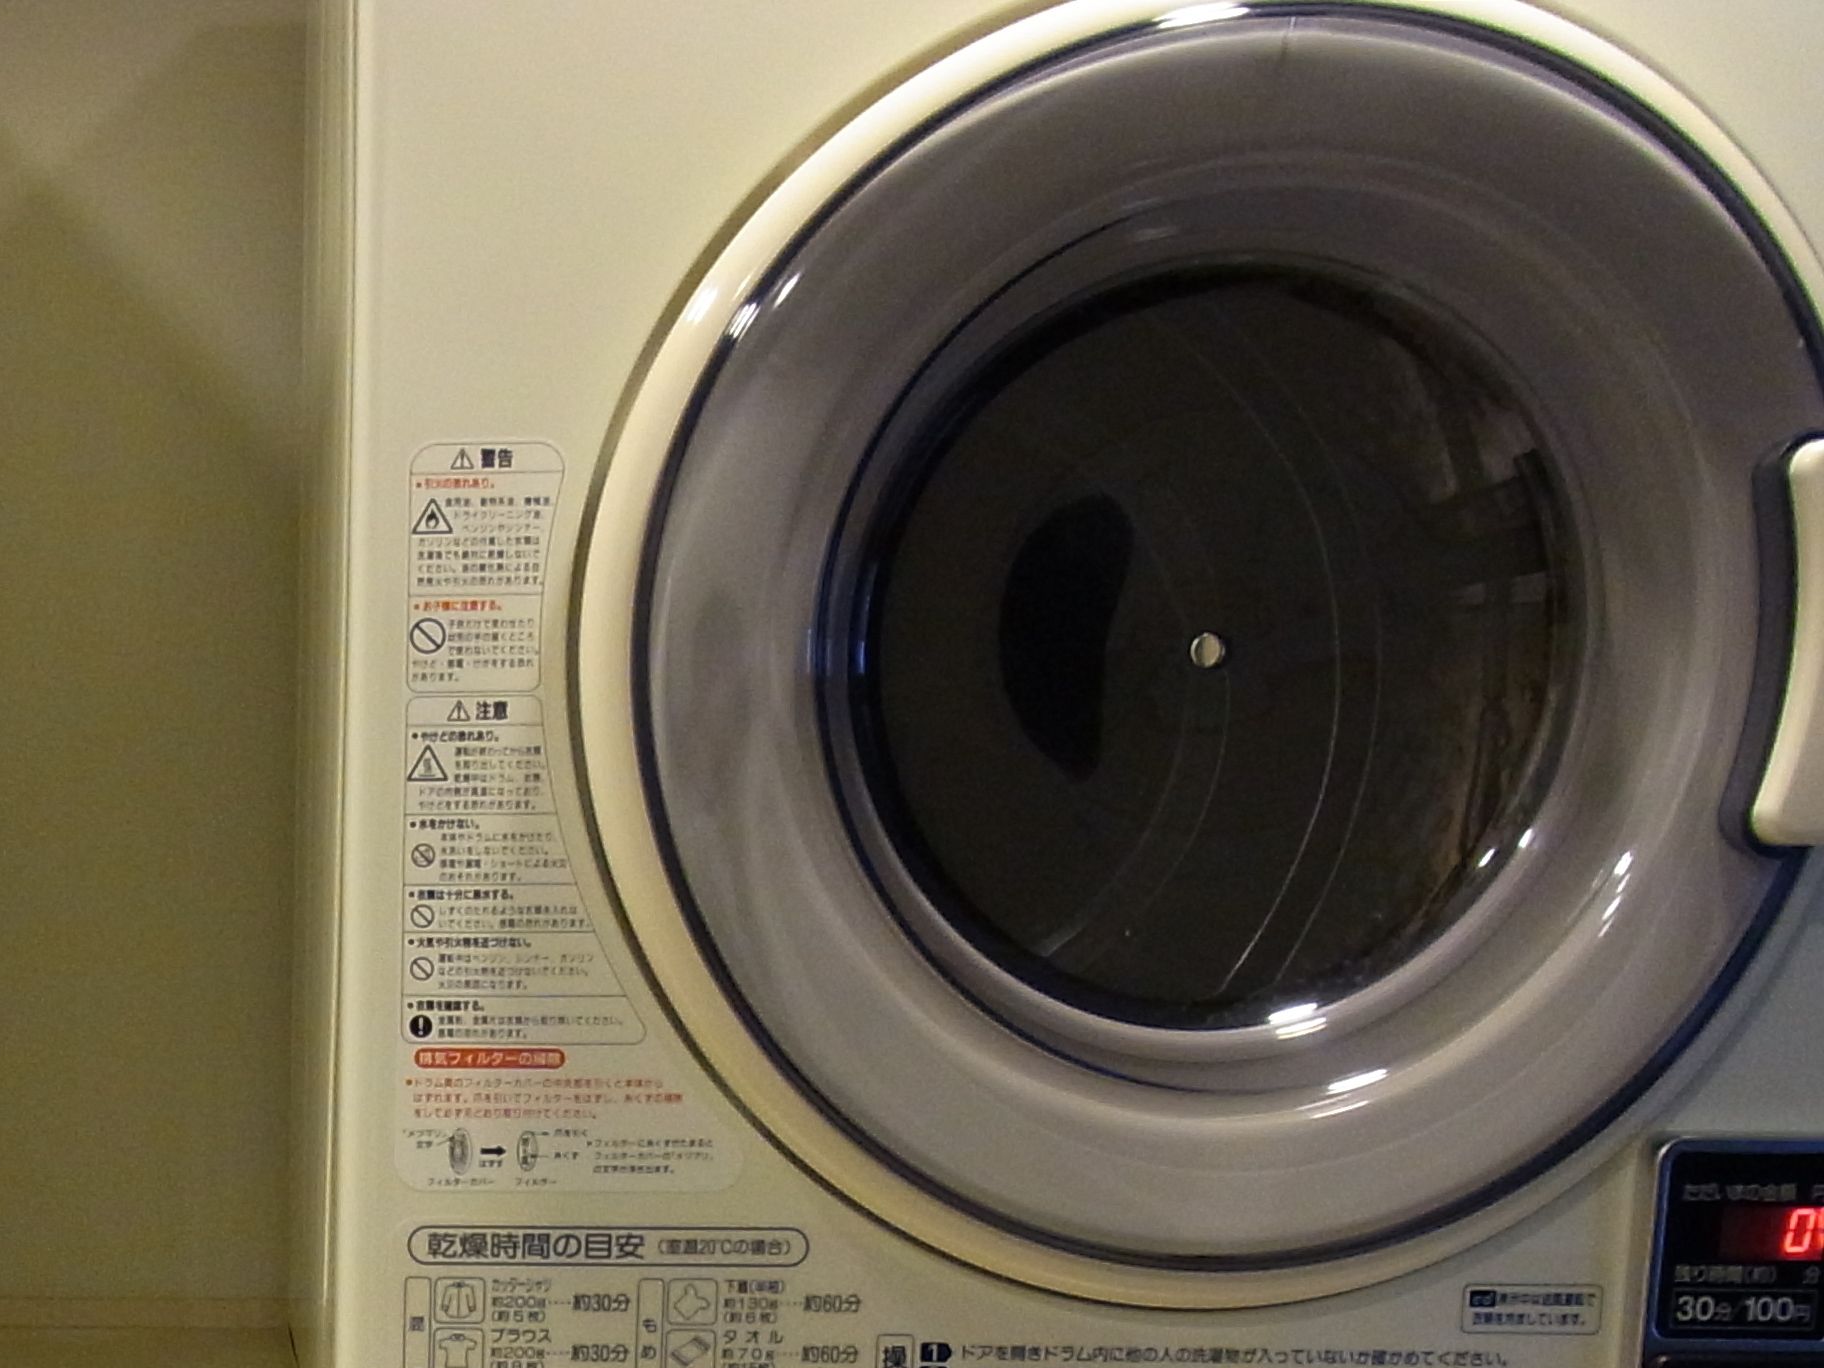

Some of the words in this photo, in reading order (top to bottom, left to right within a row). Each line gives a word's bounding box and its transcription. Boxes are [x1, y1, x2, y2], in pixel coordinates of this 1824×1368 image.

[476, 701, 508, 720] 注意
[427, 1234, 646, 1260] 乾燥時間の目安
